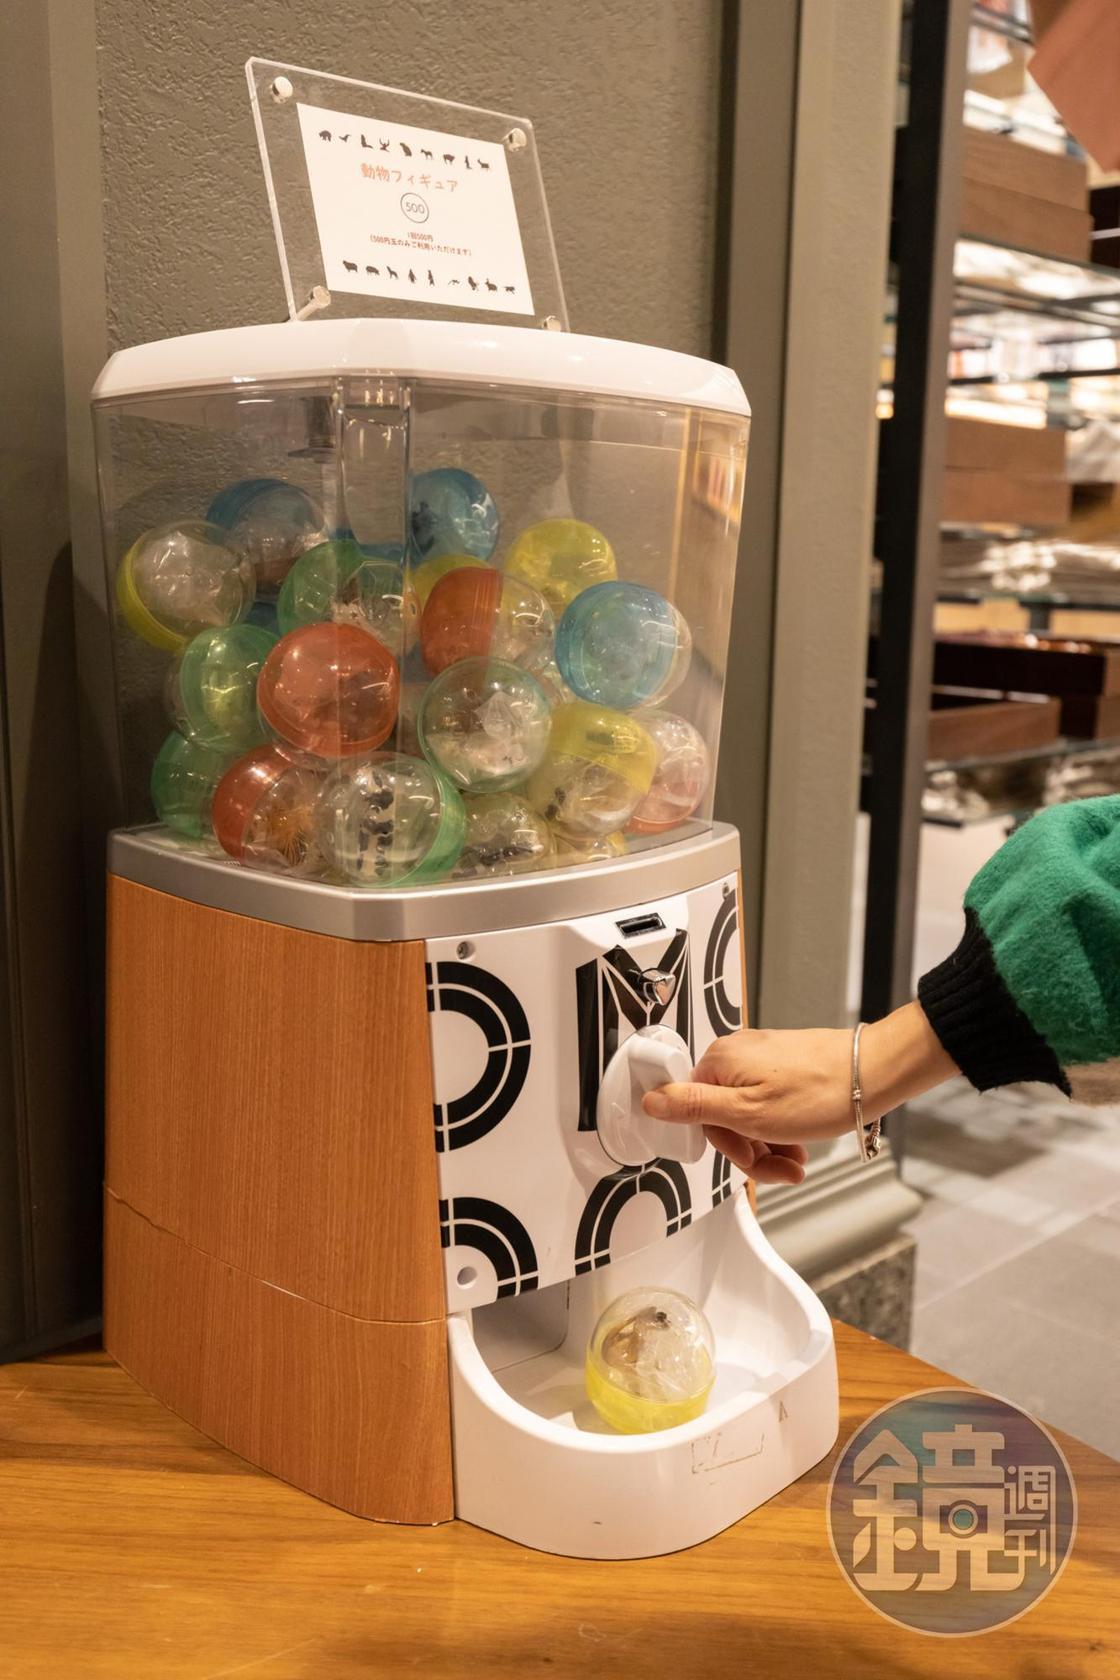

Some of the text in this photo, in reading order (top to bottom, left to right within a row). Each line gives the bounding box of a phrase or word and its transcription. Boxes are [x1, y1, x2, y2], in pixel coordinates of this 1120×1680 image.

[361, 163, 458, 192] 動物フィギュア
[405, 202, 426, 214] 500
